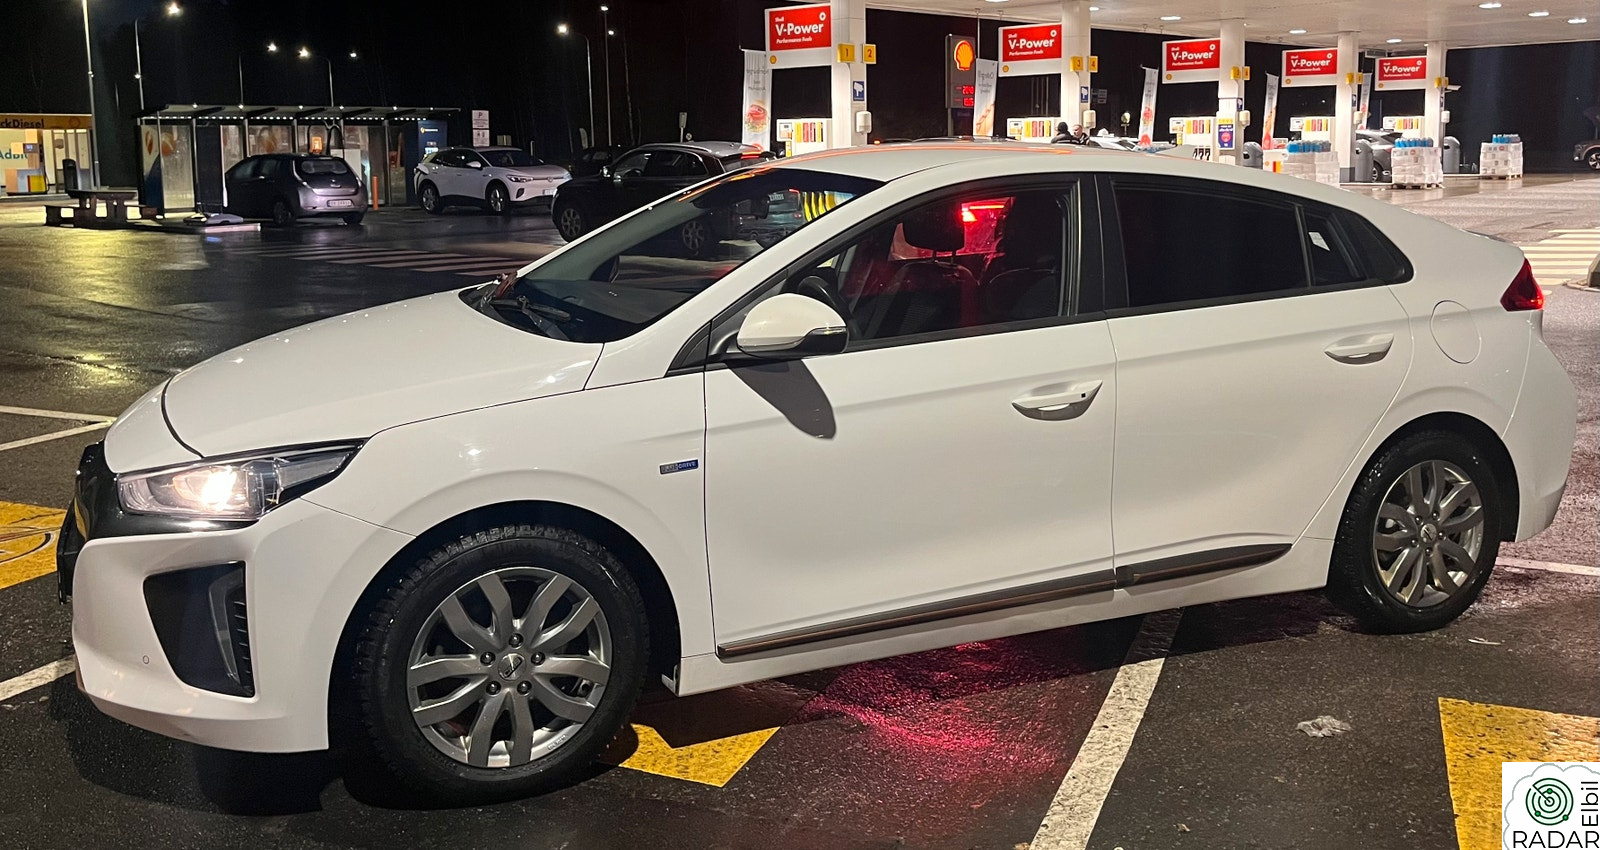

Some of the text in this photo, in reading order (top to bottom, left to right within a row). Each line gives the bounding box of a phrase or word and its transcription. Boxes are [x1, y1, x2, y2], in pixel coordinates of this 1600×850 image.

[775, 23, 824, 36] V-Power
[1008, 38, 1055, 50] V-Power
[1171, 51, 1214, 61] V-Power
[1291, 59, 1331, 68] V-Power
